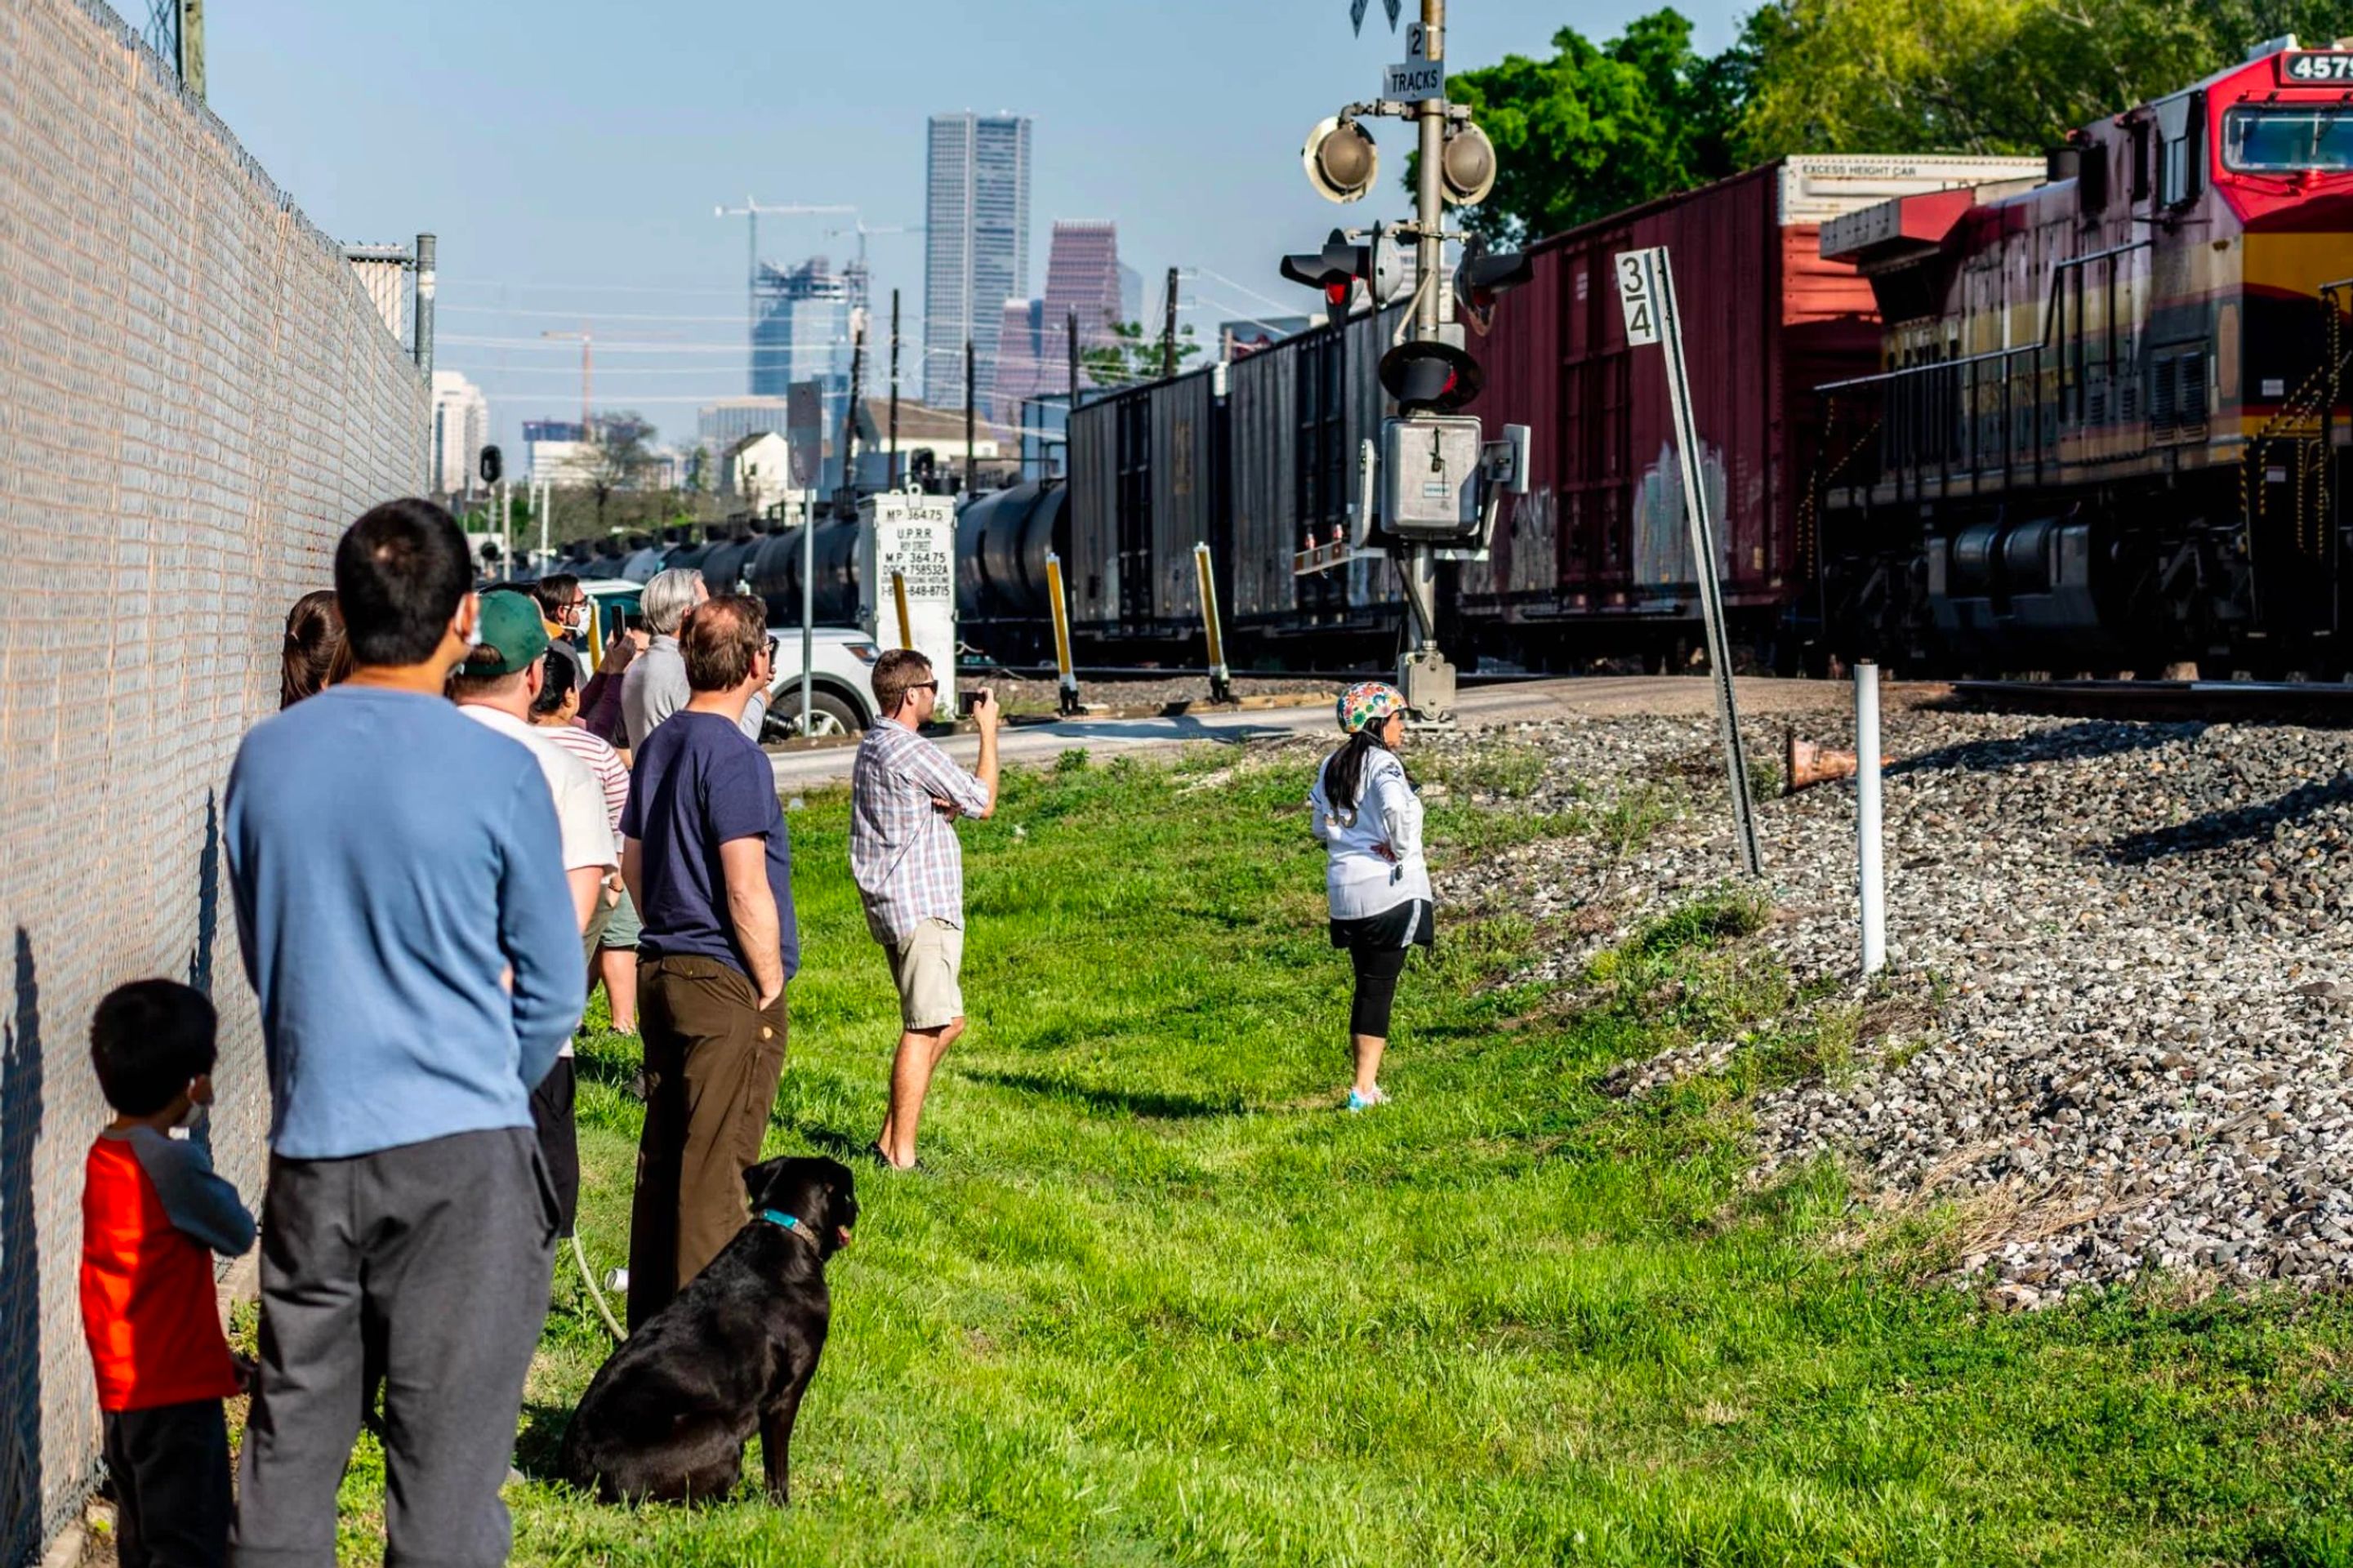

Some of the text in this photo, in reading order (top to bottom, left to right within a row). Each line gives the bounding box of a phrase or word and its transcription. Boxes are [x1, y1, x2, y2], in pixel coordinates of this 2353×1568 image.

[1411, 28, 1422, 56] 2
[2294, 56, 2353, 79] 457
[1392, 69, 1437, 92] TRACKS
[1803, 164, 1916, 176] EXCESS HEIGHT CAR
